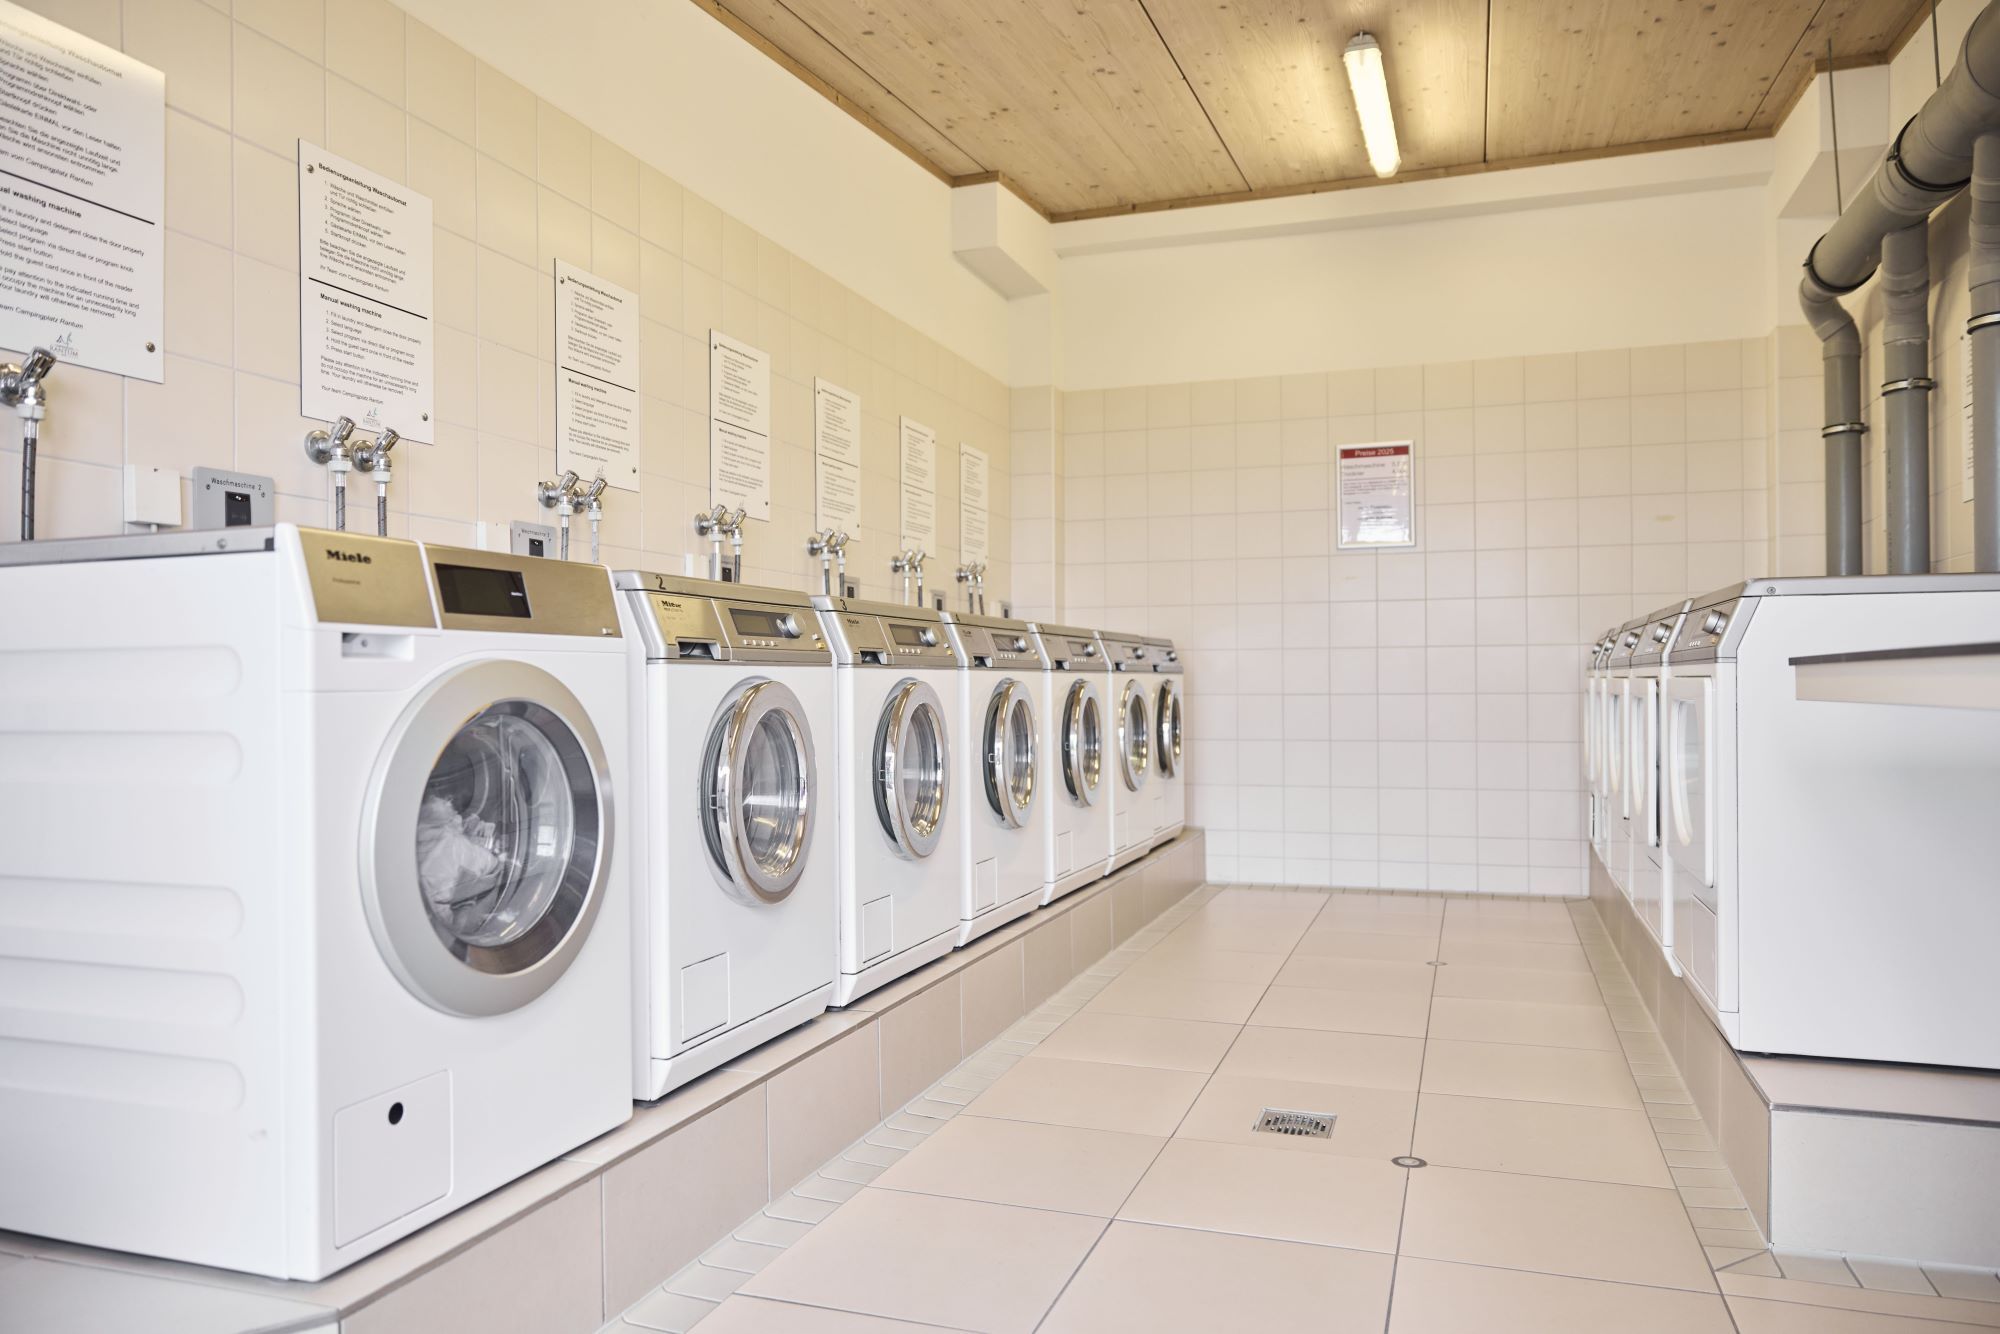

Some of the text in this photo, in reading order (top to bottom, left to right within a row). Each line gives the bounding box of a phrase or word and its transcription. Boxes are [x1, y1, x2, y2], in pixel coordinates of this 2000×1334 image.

[13, 191, 46, 207] washing
[48, 202, 81, 217] machine
[38, 285, 64, 296] machine
[340, 301, 360, 312] washing
[361, 308, 381, 318] machine
[326, 549, 372, 564] Miele
[656, 575, 666, 590] 2
[840, 599, 847, 610] 3
